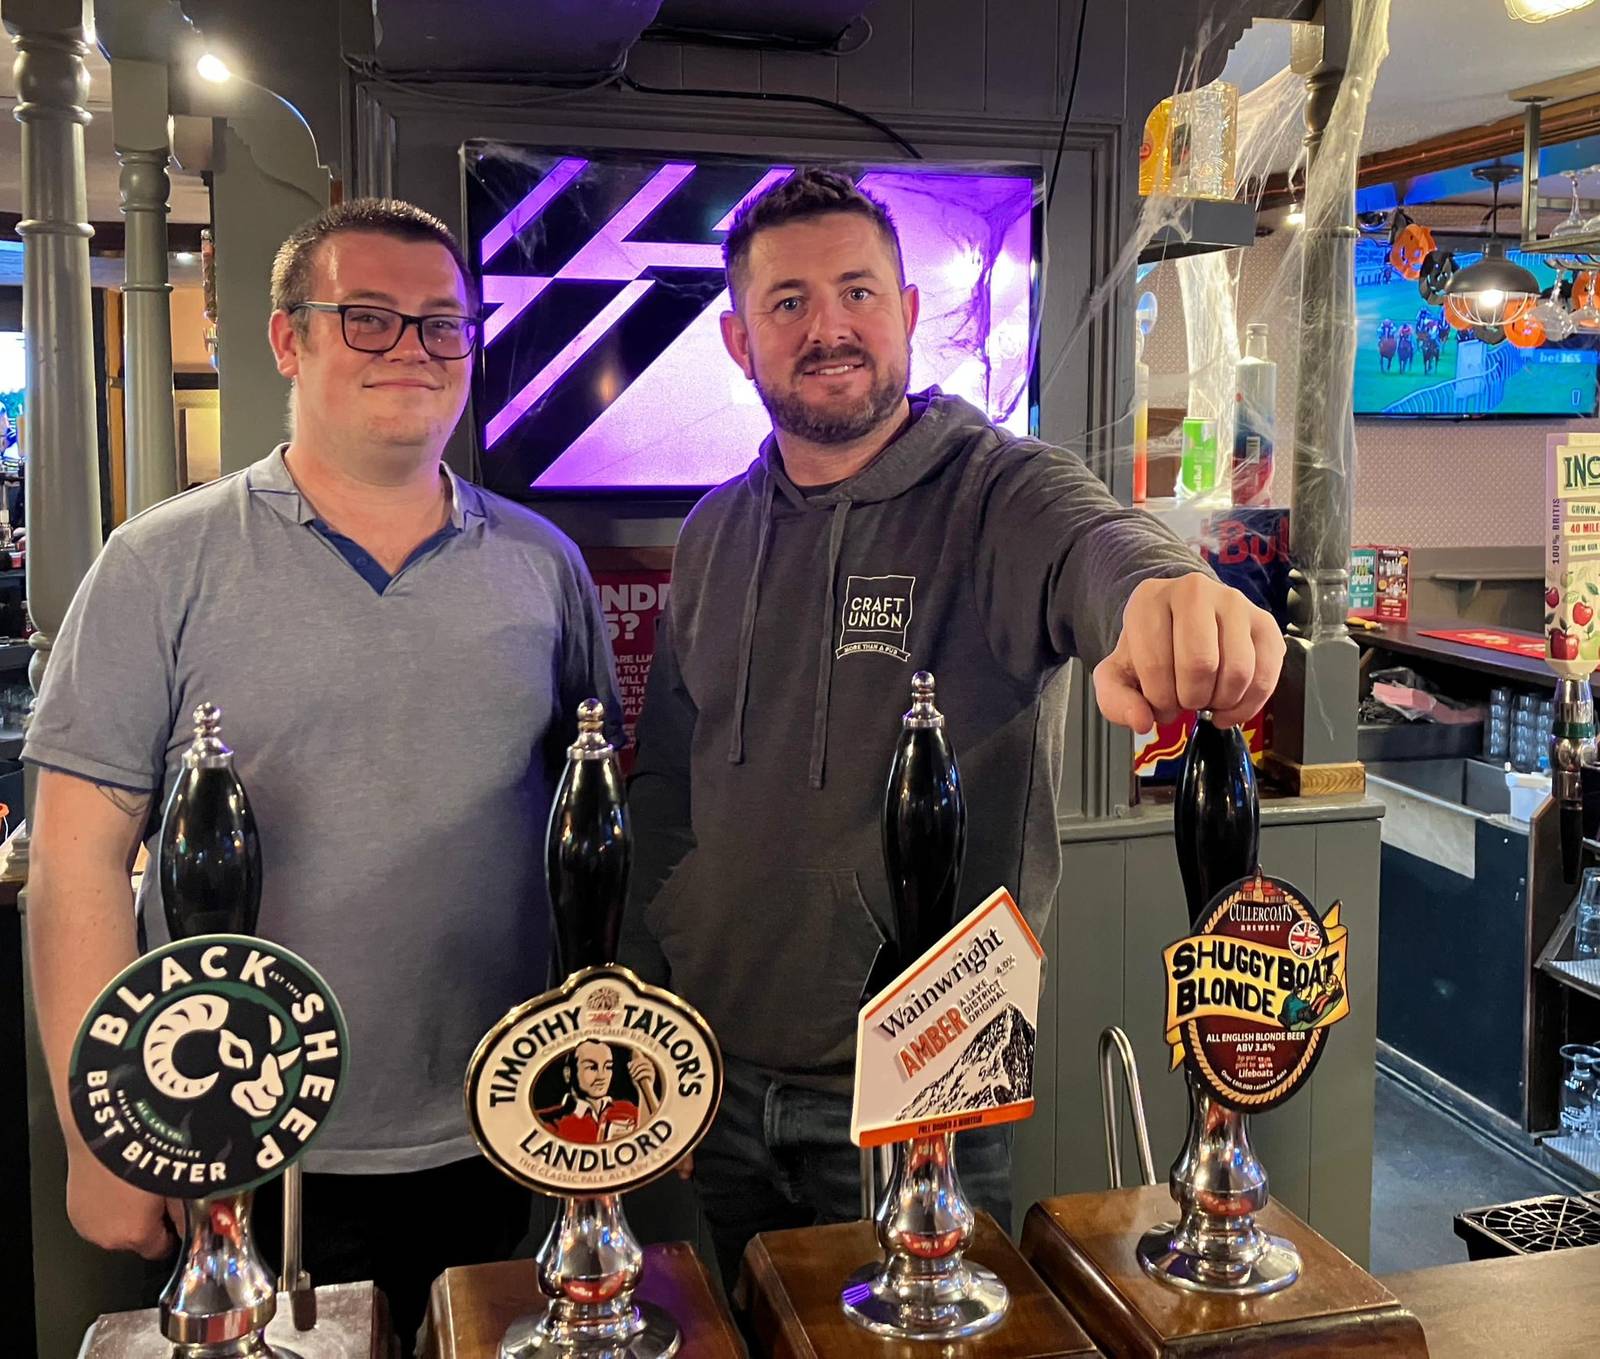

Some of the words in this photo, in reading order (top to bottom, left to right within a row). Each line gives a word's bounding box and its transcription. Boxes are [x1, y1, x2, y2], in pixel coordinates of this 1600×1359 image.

[1571, 504, 1596, 514] GROWN
[1571, 523, 1580, 533] 40
[1551, 535, 1560, 565] 100%
[851, 596, 905, 612] CRAFT
[848, 611, 902, 628] UNION
[1230, 903, 1293, 922] CULLERCOATS
[1240, 924, 1281, 932] BREWERY
[879, 927, 1004, 1039] Wainwright
[959, 998, 966, 1008] A
[966, 977, 989, 1001] LAKE
[963, 979, 1002, 1015] DISTRICT
[1176, 977, 1276, 1019] BLONDE
[968, 988, 1008, 1023] ORIGINAL
[899, 1006, 969, 1079] AMBER
[1206, 1033, 1220, 1042] ALL
[1221, 1032, 1254, 1042] ENGLISH
[1255, 1032, 1286, 1041] BLONDE
[1286, 1031, 1306, 1040] BEER
[1236, 1043, 1254, 1052] ABV
[1254, 1042, 1276, 1052] 3.8%
[89, 945, 277, 1046] BLACK
[256, 992, 339, 1170] SHEEP
[489, 1005, 582, 1108] TIMOTHY
[622, 1004, 707, 1098] TAYLOR'S
[1238, 1069, 1274, 1078] Lifeboats
[86, 1069, 125, 1138] BEST
[121, 1140, 227, 1183] BITTER
[519, 1119, 673, 1173] LANDLORD
